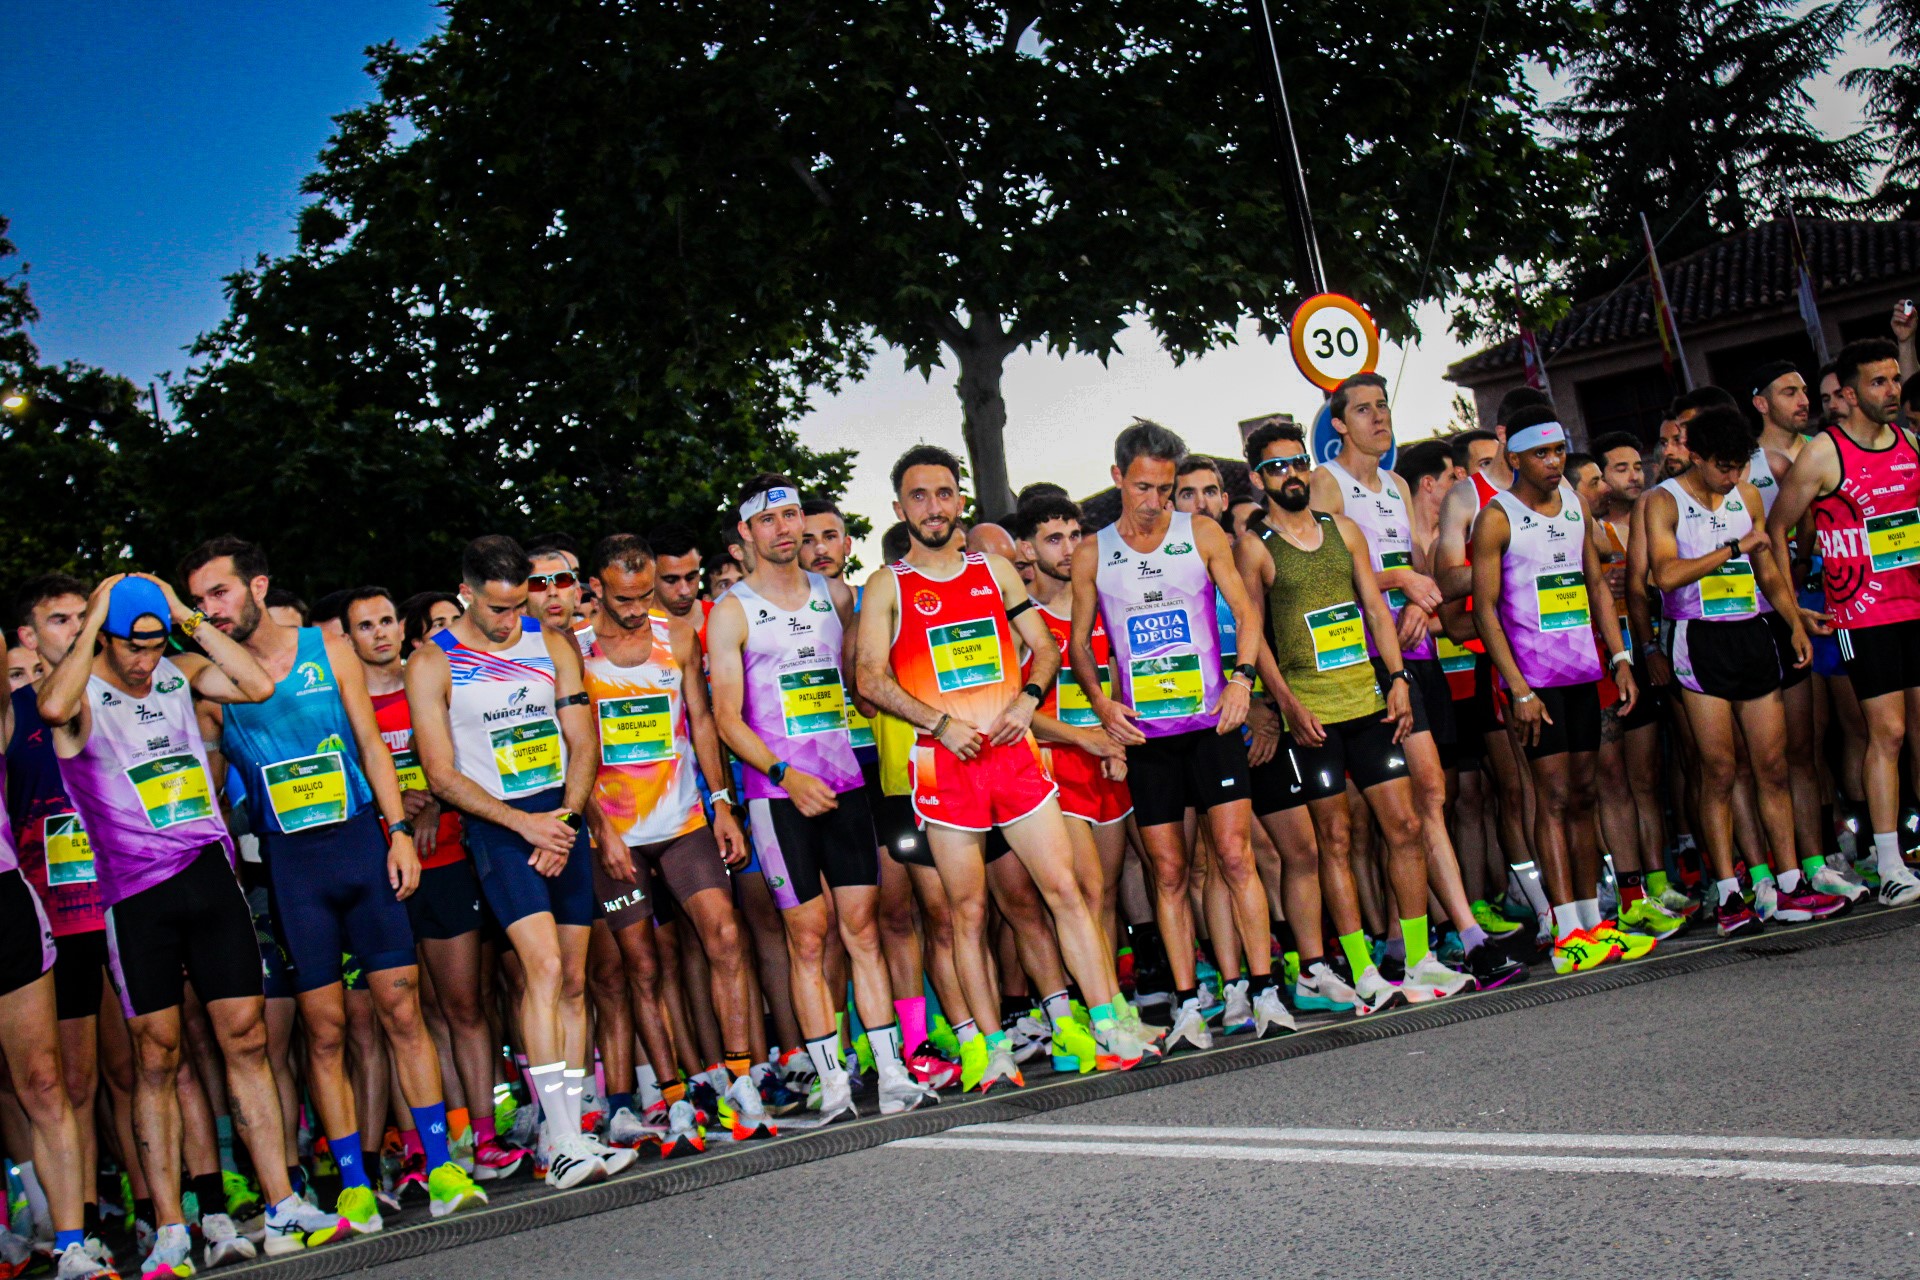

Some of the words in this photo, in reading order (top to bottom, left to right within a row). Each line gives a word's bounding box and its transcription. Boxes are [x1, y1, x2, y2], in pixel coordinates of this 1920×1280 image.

[1312, 326, 1359, 359] 30
[1519, 522, 1539, 531] VIATOR
[1107, 557, 1129, 567] VIATOR
[1555, 591, 1578, 601] YOUSSEF
[755, 615, 777, 626] VIATOR
[1133, 614, 1185, 632] AQUA
[1135, 627, 1184, 645] DEUS
[1328, 625, 1355, 637] MUSTAPHA
[952, 644, 982, 656] OSCARVM
[798, 690, 832, 702] PATALIEBRE
[483, 707, 523, 724] Núñez
[616, 720, 657, 731] ABDELMAJID
[512, 743, 548, 758] GUTIERREZ
[527, 756, 537, 764] 34
[160, 776, 189, 790] MOROTE
[292, 781, 323, 794] RAULICO
[303, 792, 315, 800] 27
[71, 838, 81, 848] EL
